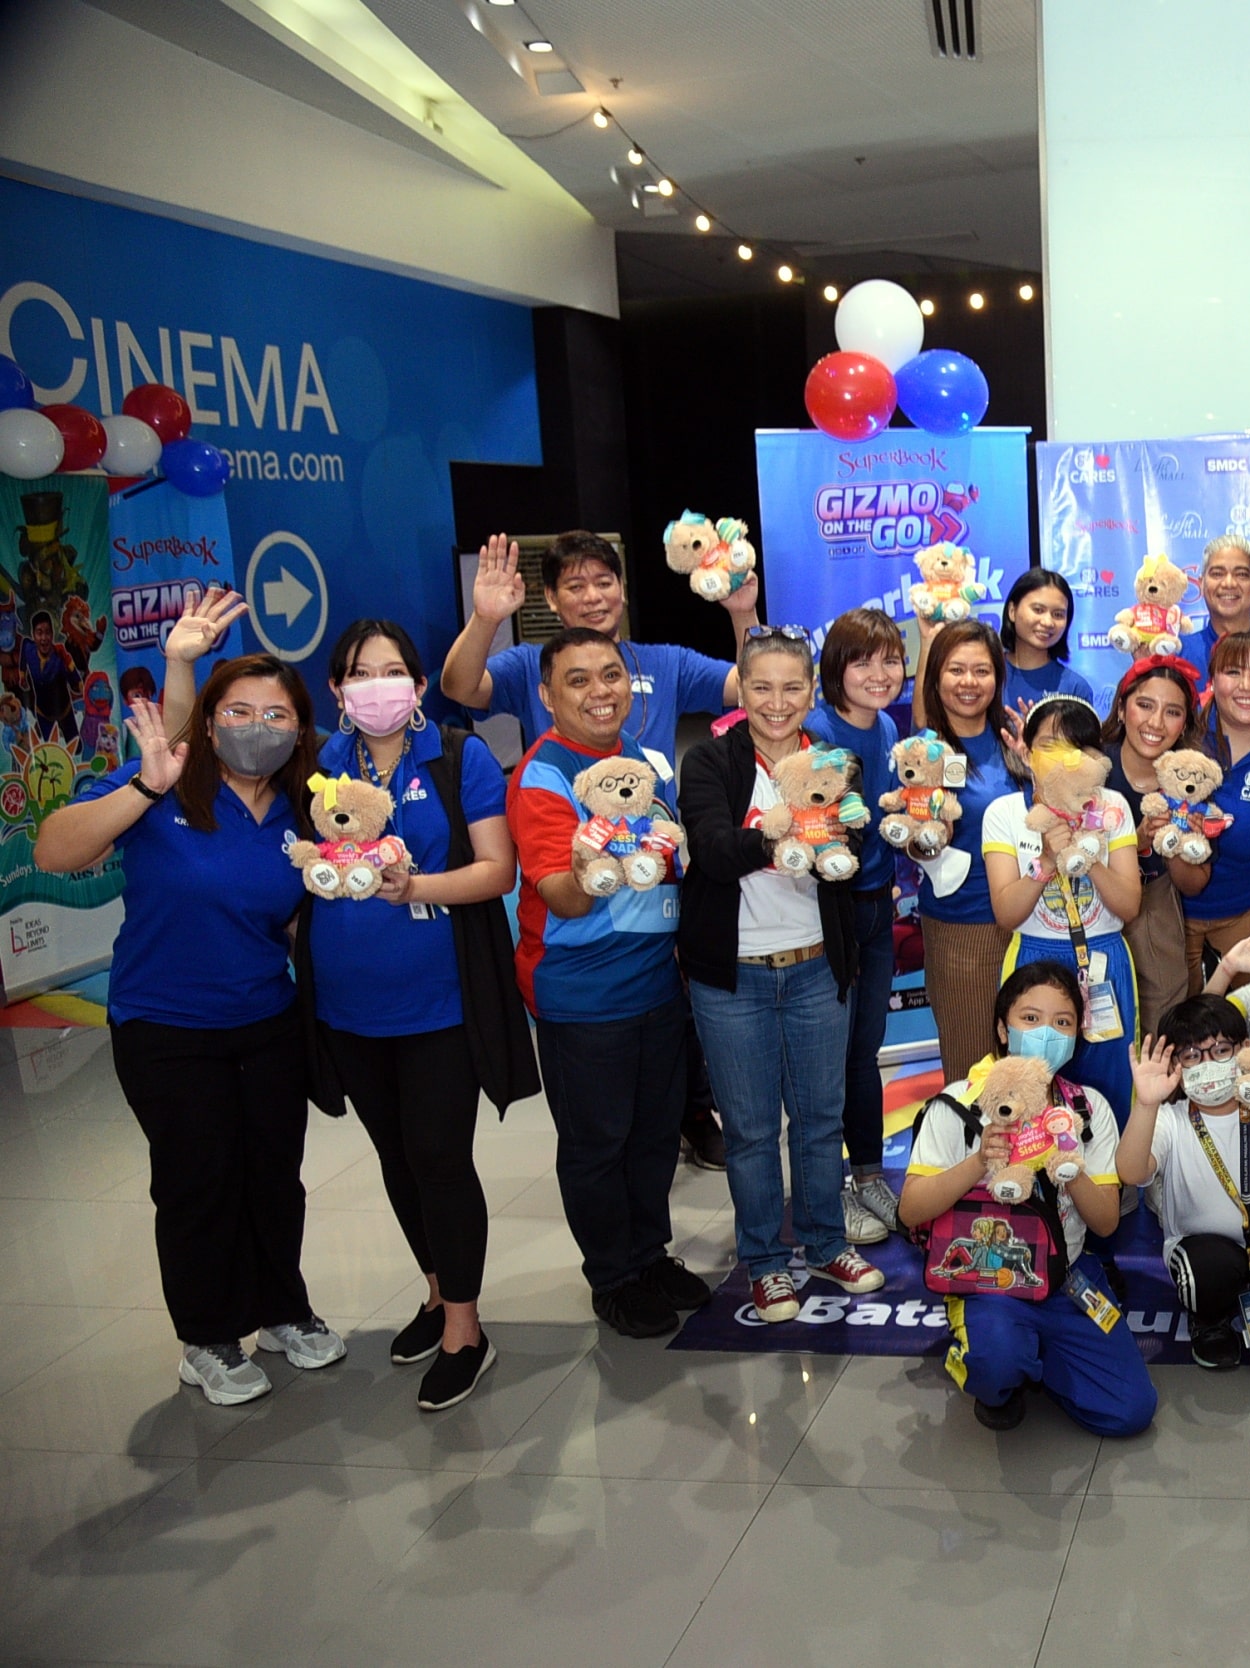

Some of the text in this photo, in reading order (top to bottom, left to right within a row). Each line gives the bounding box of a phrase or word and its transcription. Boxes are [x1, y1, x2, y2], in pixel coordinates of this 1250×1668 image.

[0, 281, 339, 434] CINEMA
[225, 449, 346, 482] ema.com
[1207, 459, 1247, 472] SMDC
[1070, 470, 1115, 483] CARES
[818, 483, 937, 521] GIZMO
[823, 515, 931, 549] ON THE GO!
[1075, 586, 1119, 598] CARES
[119, 623, 159, 641] ON THE
[1081, 633, 1111, 647] SMD
[910, 807, 928, 816] MOM
[1019, 841, 1041, 853] MICA
[0, 863, 33, 888] Sundays
